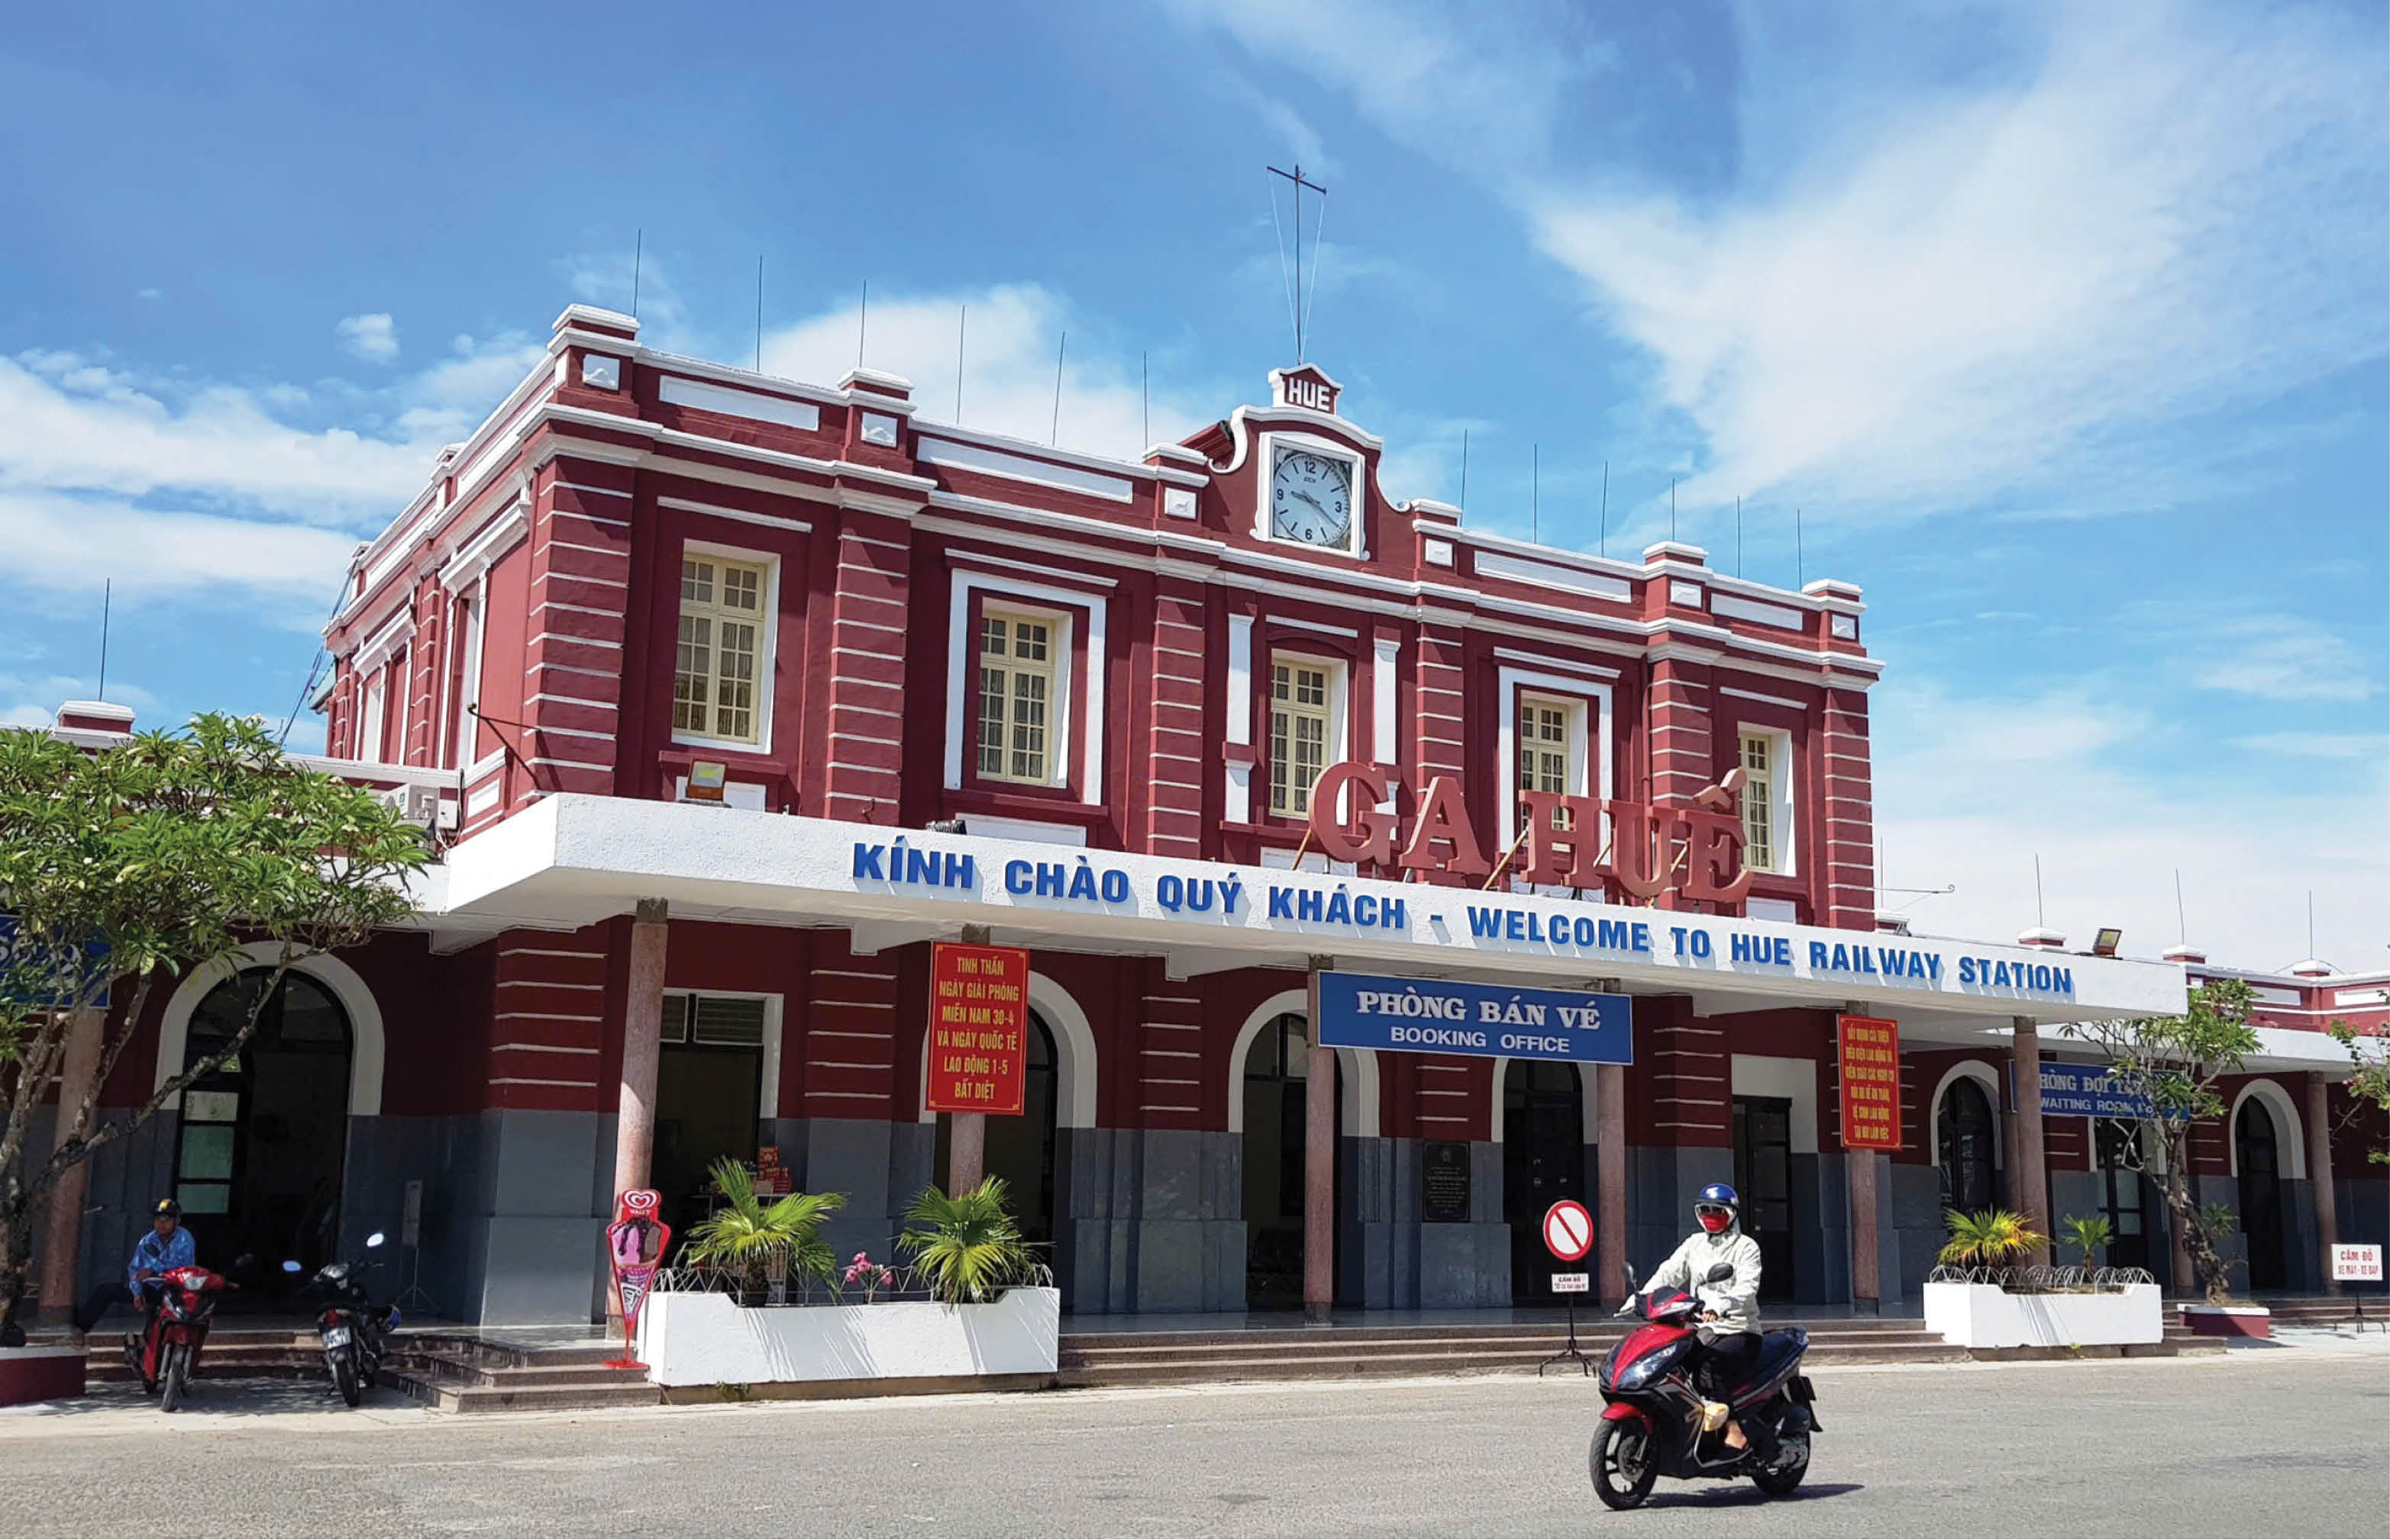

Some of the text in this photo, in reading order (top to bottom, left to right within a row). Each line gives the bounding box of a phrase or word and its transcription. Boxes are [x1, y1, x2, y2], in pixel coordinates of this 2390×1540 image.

[1288, 377, 1330, 412] HUE
[1304, 460, 1316, 474] 12
[1276, 488, 1284, 501] 9
[1335, 501, 1342, 514] 3
[1305, 528, 1313, 541] 6
[1309, 760, 1754, 903] GA HUẾ
[854, 835, 974, 889] KÍNH
[1005, 855, 1129, 903] CHÀO
[1157, 873, 1242, 914] QUÝ
[1269, 883, 1405, 929] KHÁCH
[1468, 906, 1649, 952] WELCOME
[1671, 927, 1710, 959] TO
[1731, 934, 1791, 967] HUE
[1809, 941, 1940, 980] RAILWAY
[1959, 957, 2072, 994] STATION
[957, 957, 978, 973] TINH
[970, 1007, 990, 1024] NAM
[993, 1009, 1014, 1025] 30-4
[1356, 986, 1601, 1030] PHÒNG BÁN VÉ
[980, 1030, 1004, 1051] QUỐC
[1390, 1026, 1570, 1053] BOOKING OFFICE
[944, 1056, 961, 1073] LAO
[993, 1059, 1008, 1075] 1-5
[954, 1077, 996, 1103] BẤT DIỆT
[2040, 1097, 2091, 1110] WAITING
